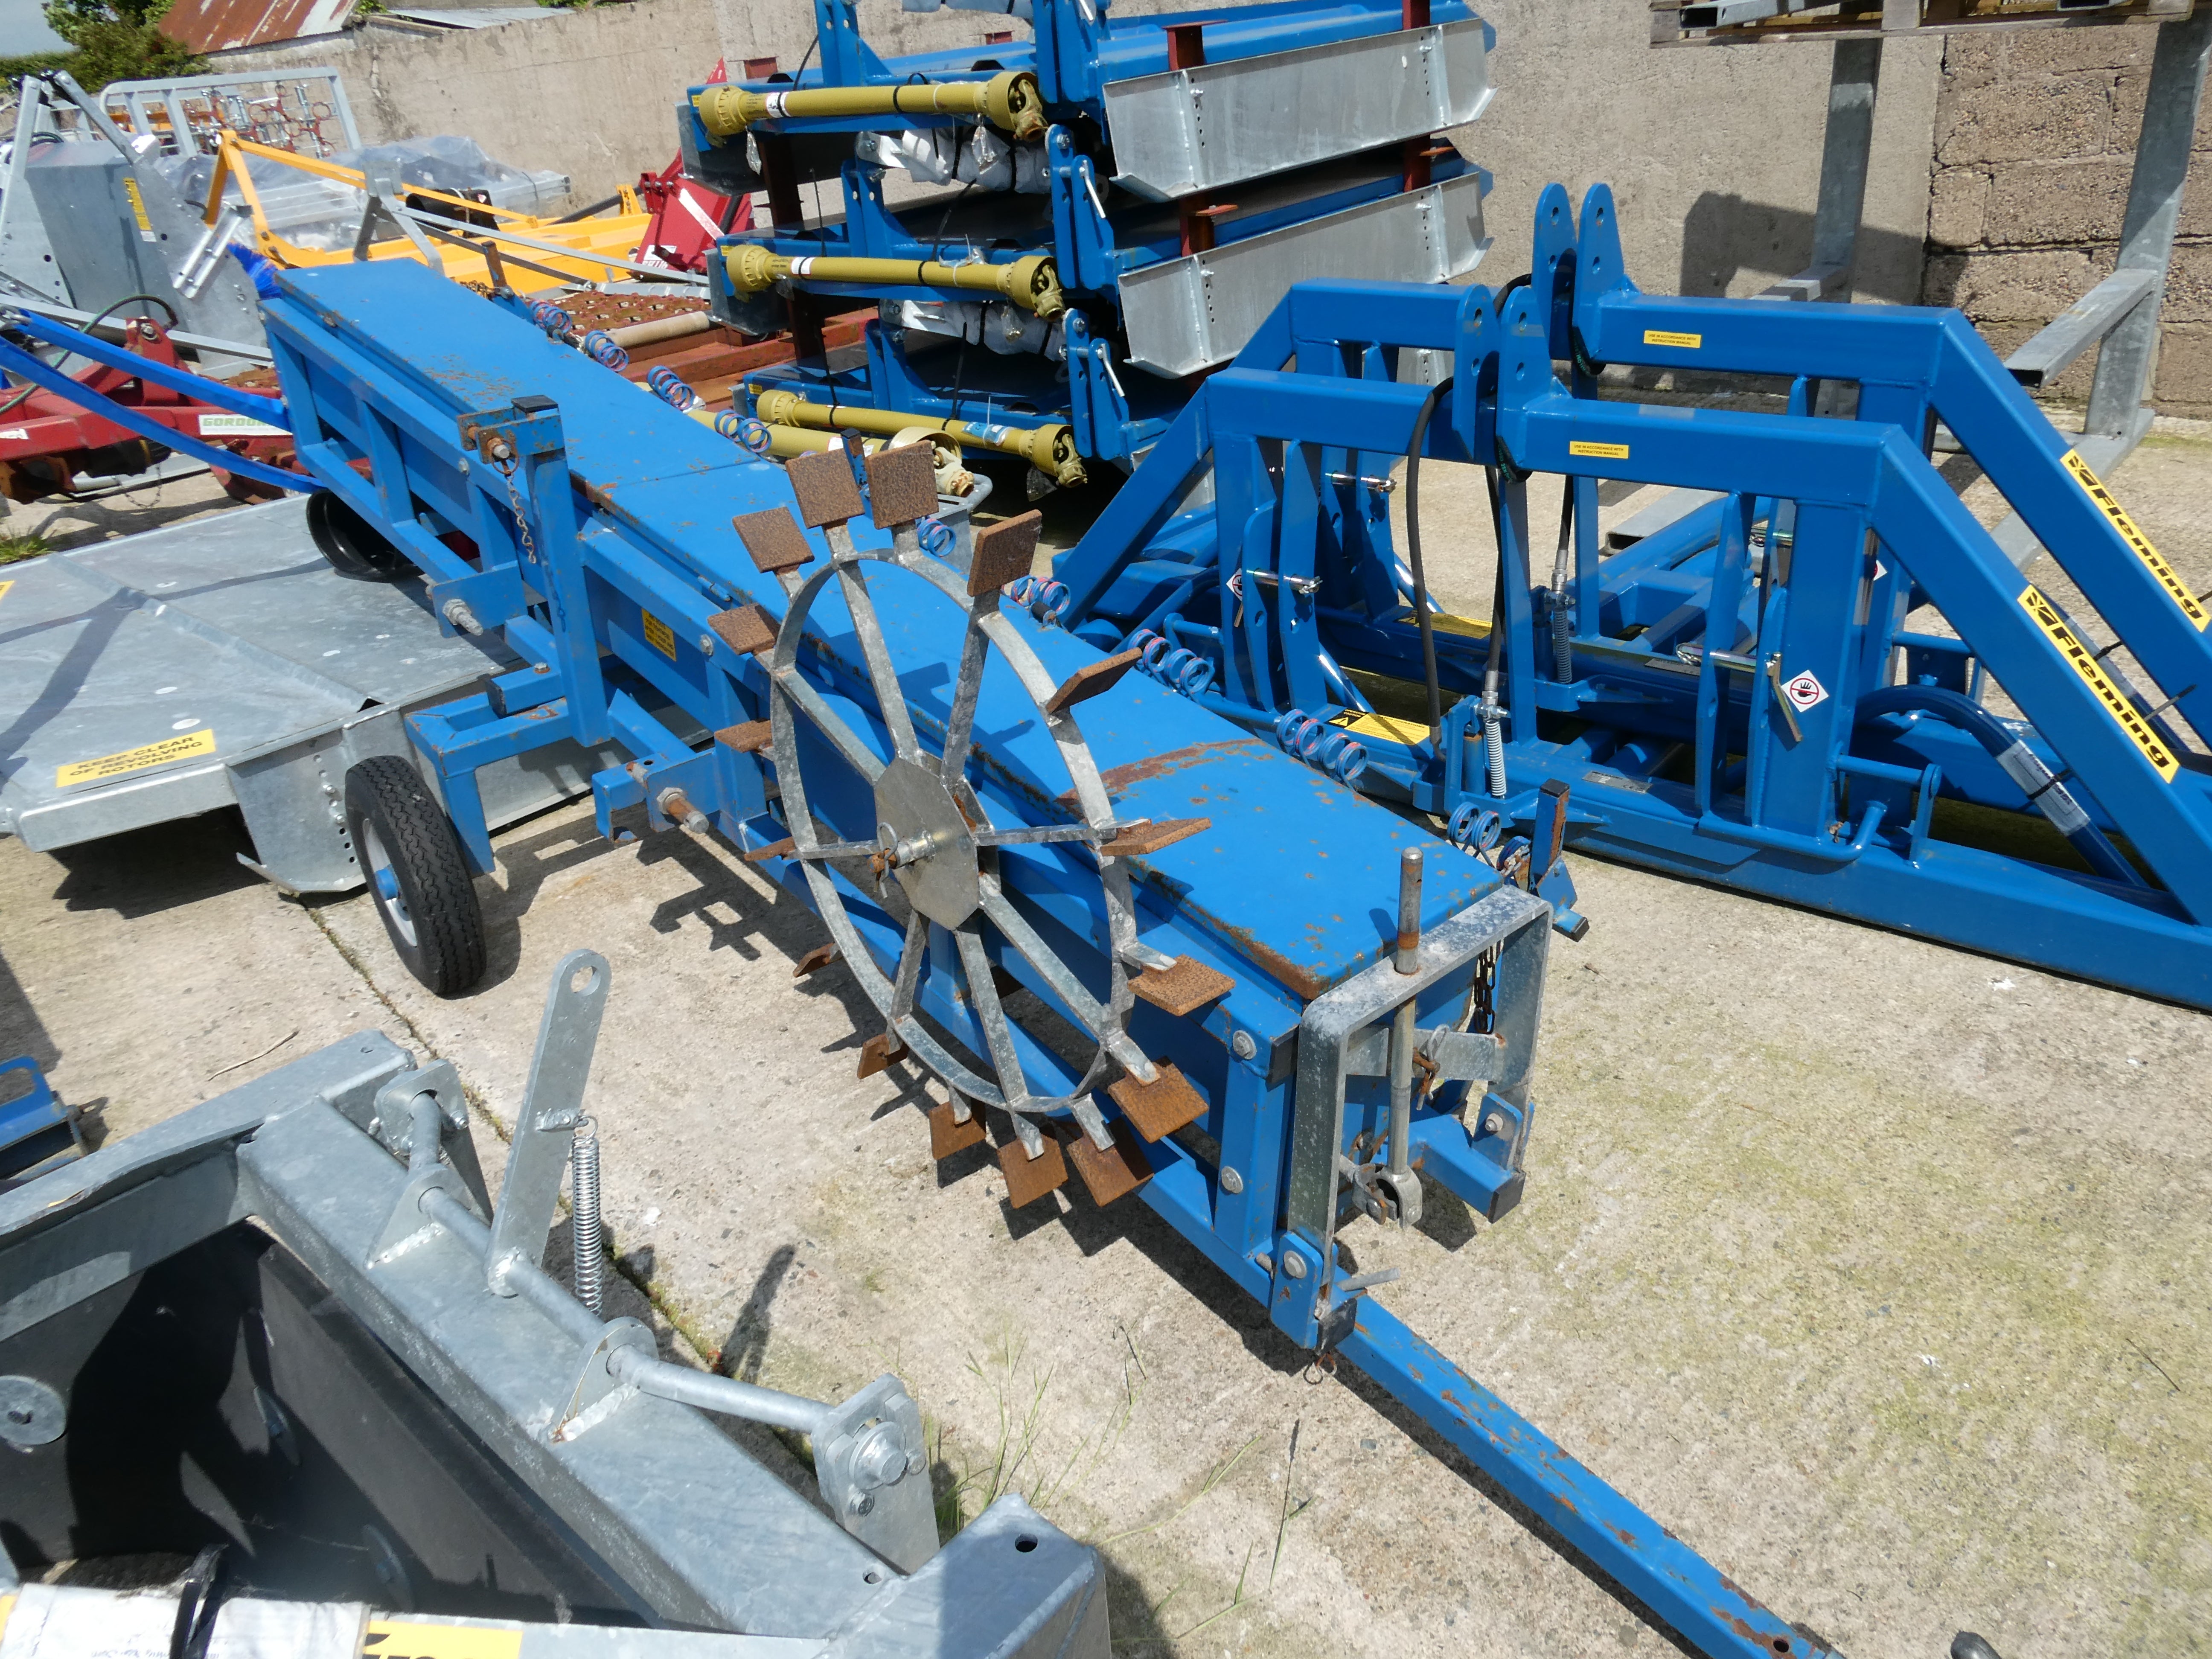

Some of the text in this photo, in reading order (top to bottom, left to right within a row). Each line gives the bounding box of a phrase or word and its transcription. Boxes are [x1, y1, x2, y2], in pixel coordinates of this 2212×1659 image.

[2092, 488, 2203, 619] Fleming
[2052, 626, 2170, 768] Fleming
[70, 741, 203, 776] OF REVOLVING
[77, 736, 194, 769] KEEP CLEAR
[98, 754, 176, 775] ROTORS
